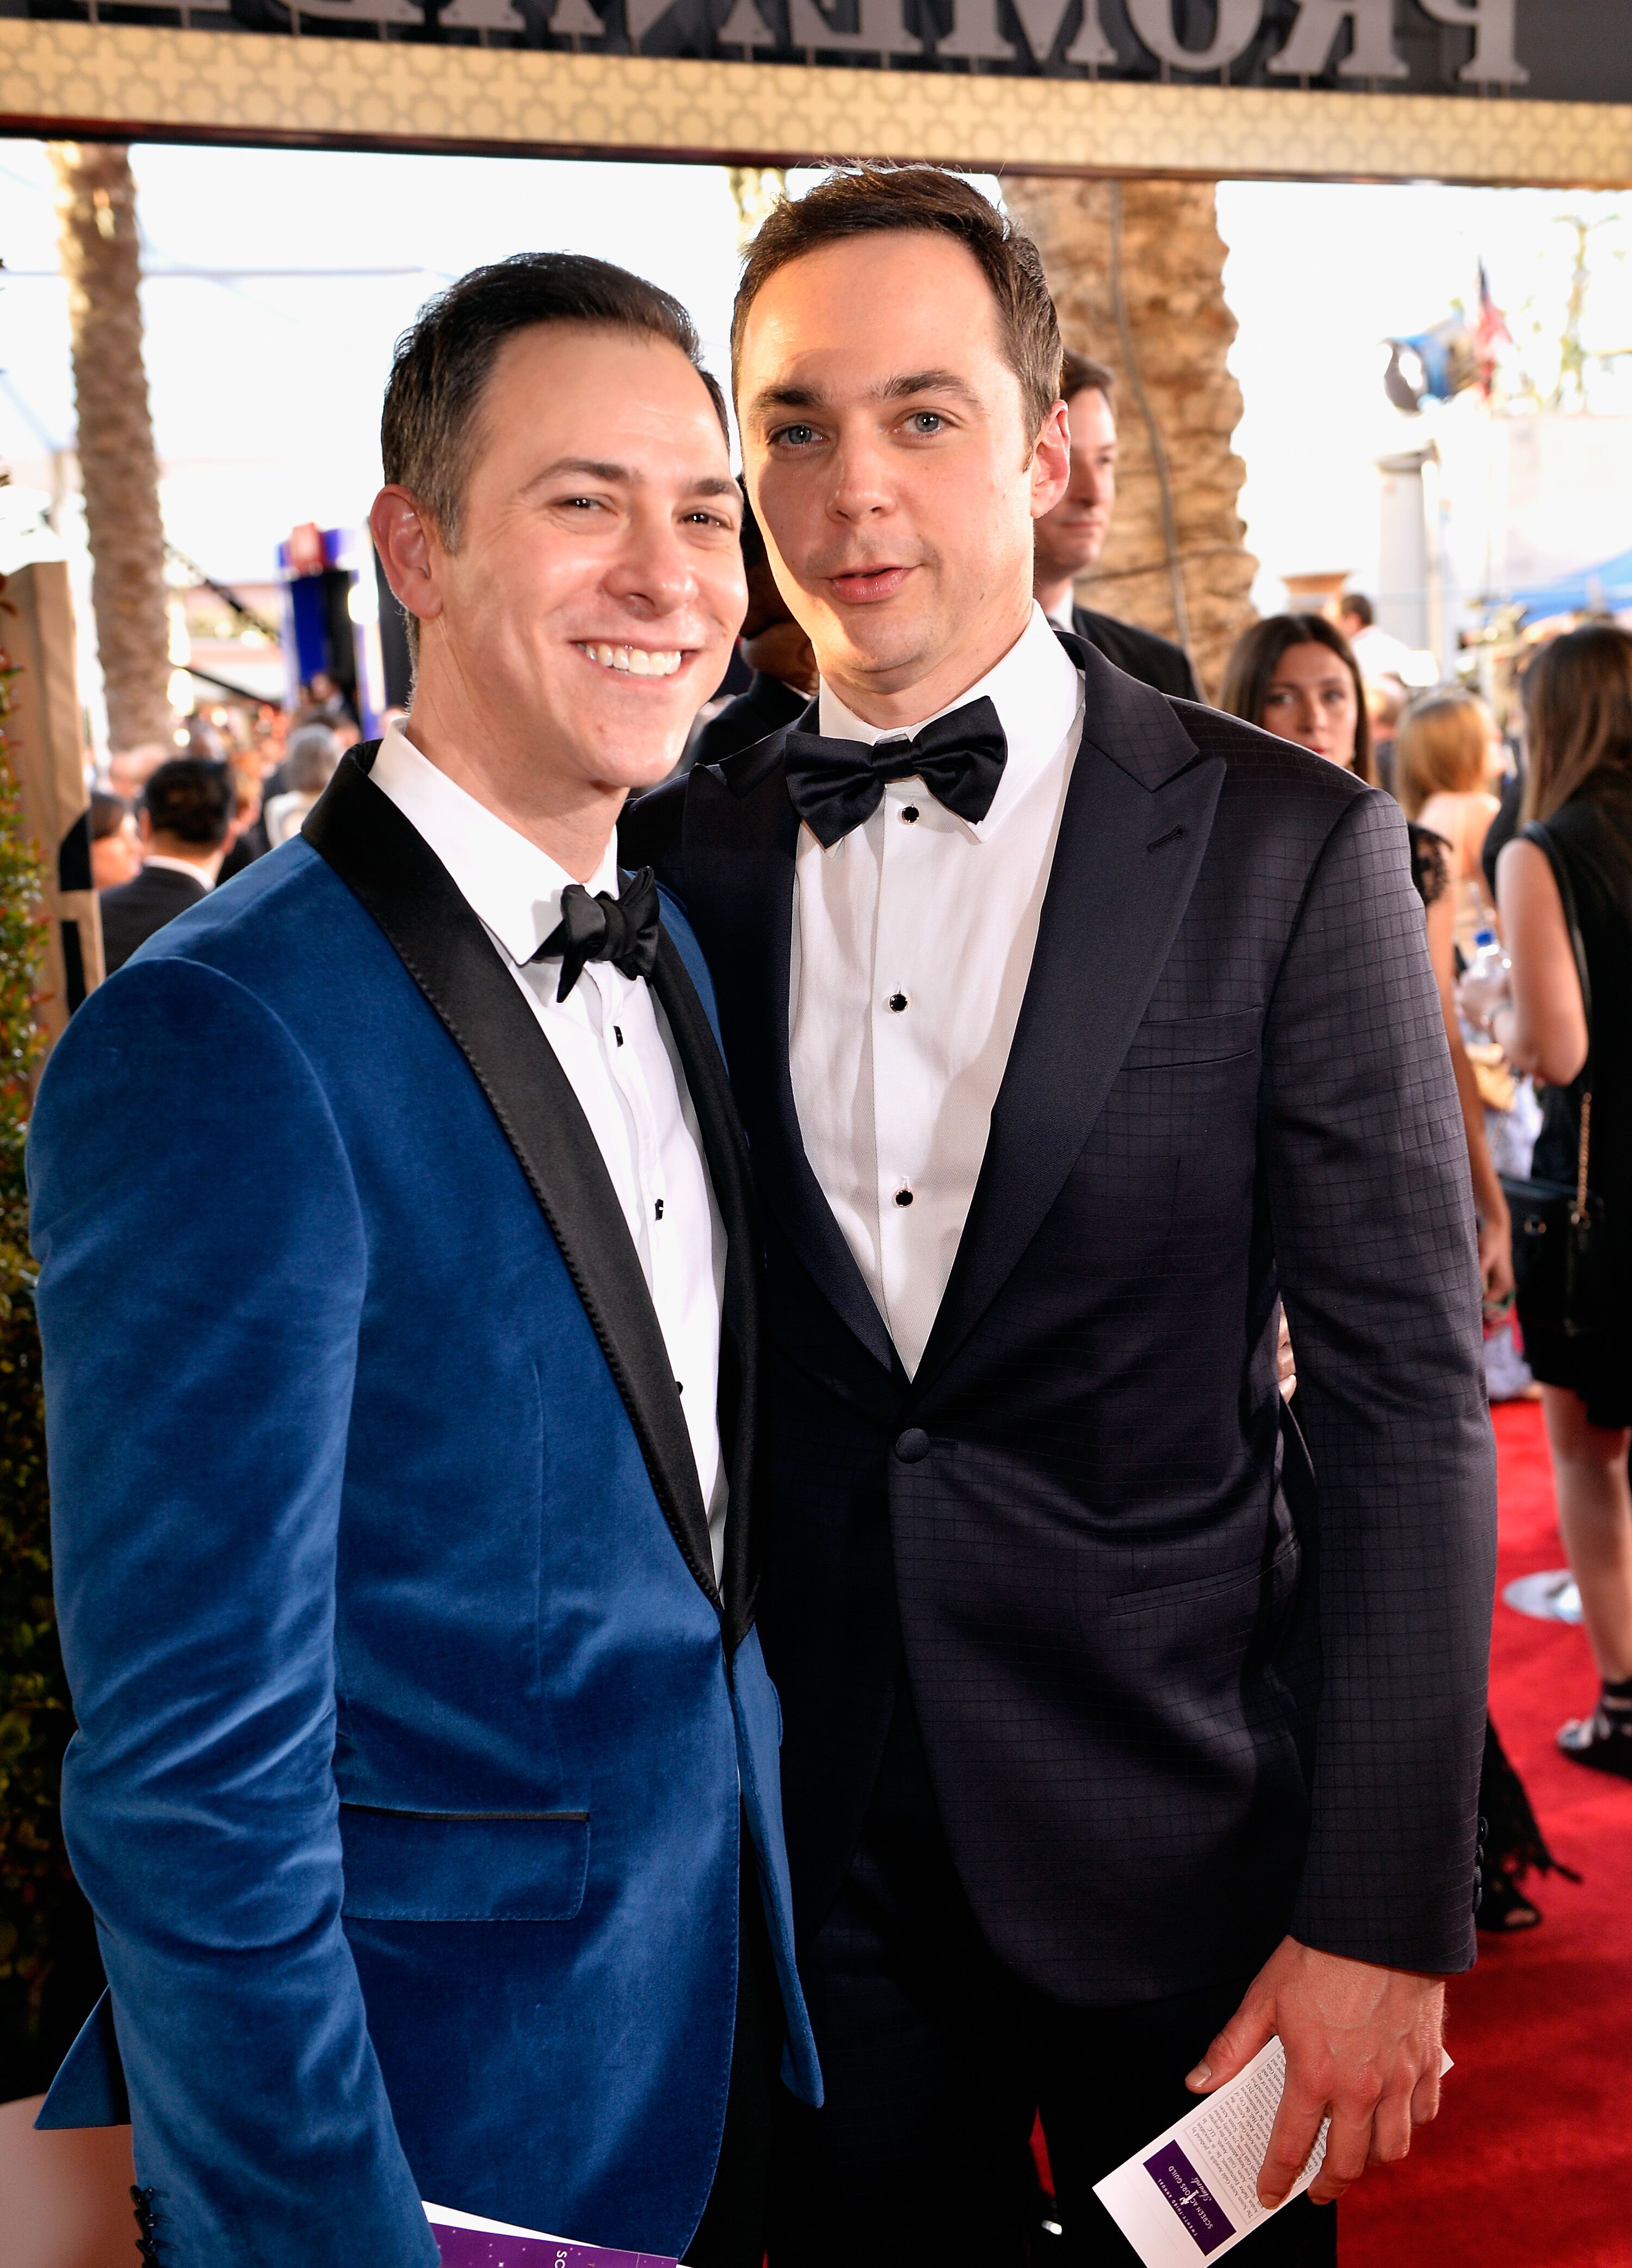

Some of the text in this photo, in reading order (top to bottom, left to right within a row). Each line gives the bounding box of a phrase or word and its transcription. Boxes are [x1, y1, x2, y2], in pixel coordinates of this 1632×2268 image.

[1266, 2063, 1275, 2075] Gala
[1270, 2058, 1278, 2067] and
[1250, 2077, 1259, 2089] Post
[1272, 2073, 1284, 2089] Awards
[1256, 2085, 1264, 2094] and
[1265, 2085, 1274, 2097] claim
[1240, 2086, 1260, 2115] Entertainment
[1253, 2092, 1265, 2110] vendors,
[1262, 2093, 1276, 2110] program
[1214, 2109, 1225, 2123] release
[1219, 2104, 1230, 2118] Actors
[1225, 2100, 1239, 2120] American
[1208, 2114, 1222, 2130] program
[1228, 2118, 1239, 2133] Screen
[1237, 2121, 1247, 2133] Guild
[1245, 2120, 1256, 2133] Radio
[1221, 2122, 1233, 2137] hereby
[1253, 2132, 1261, 2140] and
[1194, 2133, 1210, 2151] produced
[1245, 2131, 1256, 2145] Actors
[1253, 2143, 1264, 2158] Screen
[1227, 2156, 1237, 2169] Guild
[1244, 2155, 1252, 2166] Gala
[1237, 2170, 1247, 2183] Actors
[1250, 2164, 1259, 2176] wards
[1220, 2172, 1231, 2184] Guild
[1229, 2183, 1239, 2197] Actors
[1239, 2185, 1250, 2200] Harbor
[1169, 2166, 1213, 2229] SCREEN ACORS GUILD
[1238, 2196, 1248, 2210] Screen
[1158, 2179, 1197, 2236] TWENTY-THIRD ANNUAL
